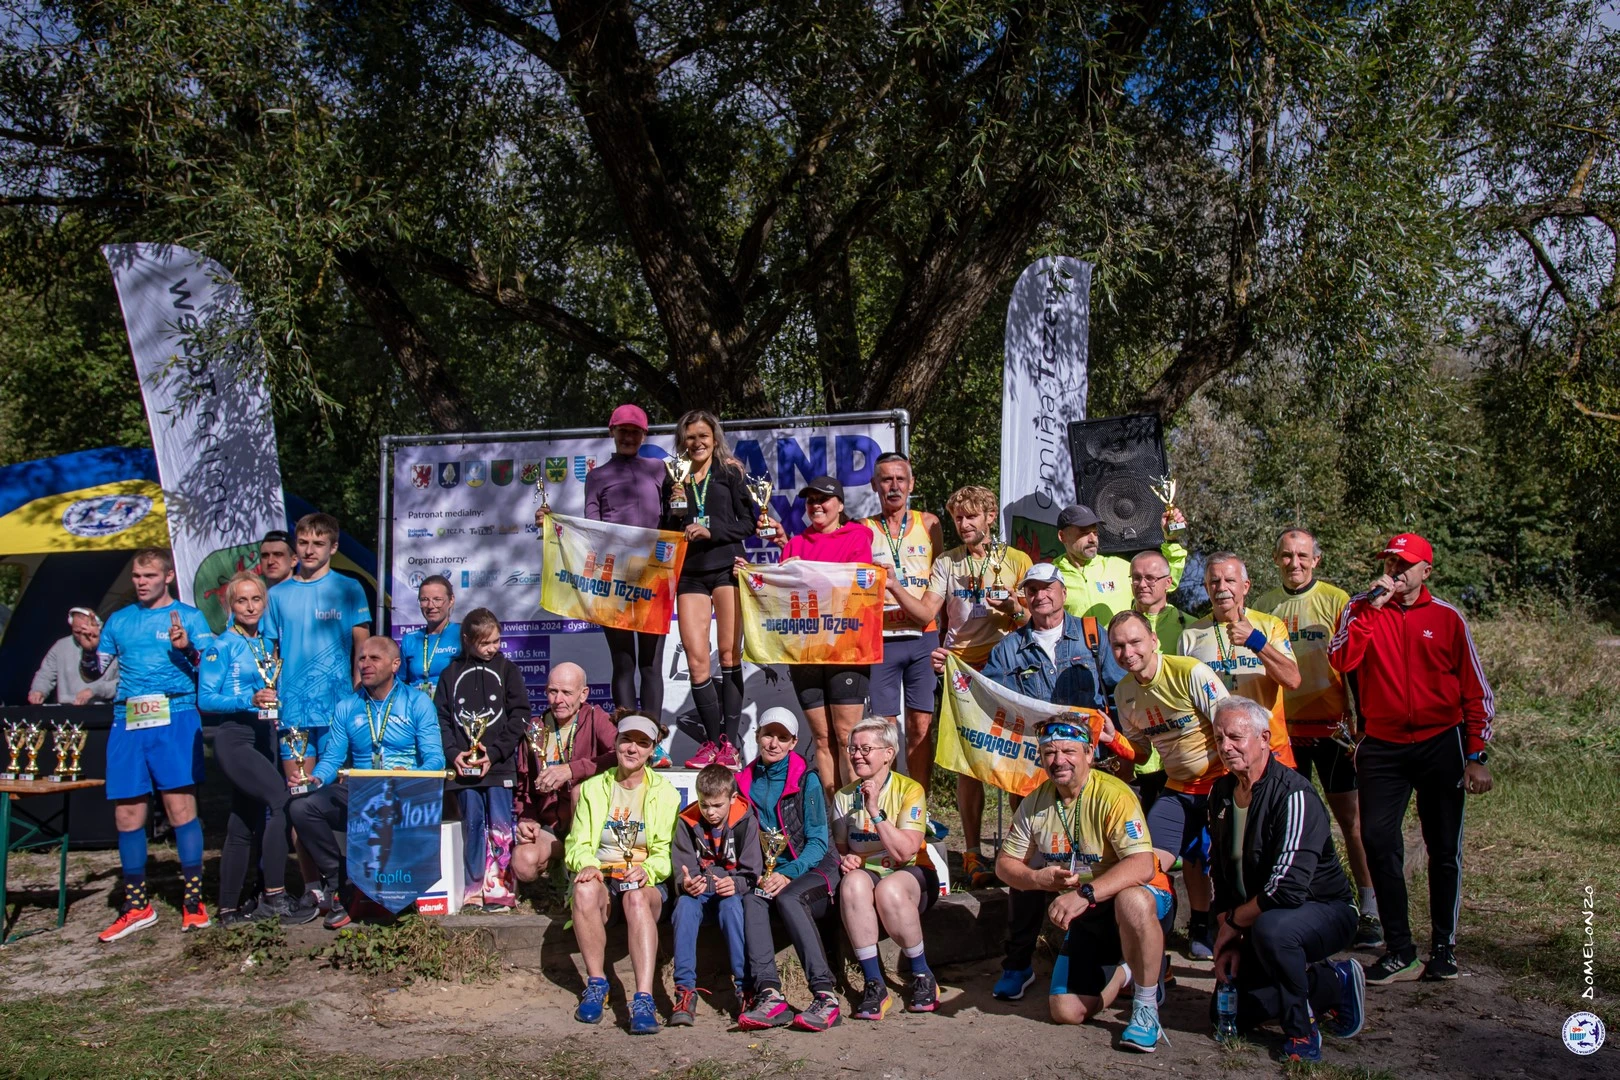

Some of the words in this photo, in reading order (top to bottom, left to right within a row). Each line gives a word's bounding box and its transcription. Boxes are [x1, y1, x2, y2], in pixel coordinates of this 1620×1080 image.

[1035, 394, 1055, 510] Gmina
[408, 510, 443, 520] Patronat
[445, 509, 484, 518] medialny:
[408, 556, 468, 566] Organizatorzy:
[504, 622, 540, 632] kwietnia
[542, 622, 562, 630] 2024
[568, 620, 600, 632] dystans
[514, 650, 530, 659] 10,5
[532, 649, 546, 658] km
[518, 664, 546, 674] ompą
[133, 701, 160, 715] 108
